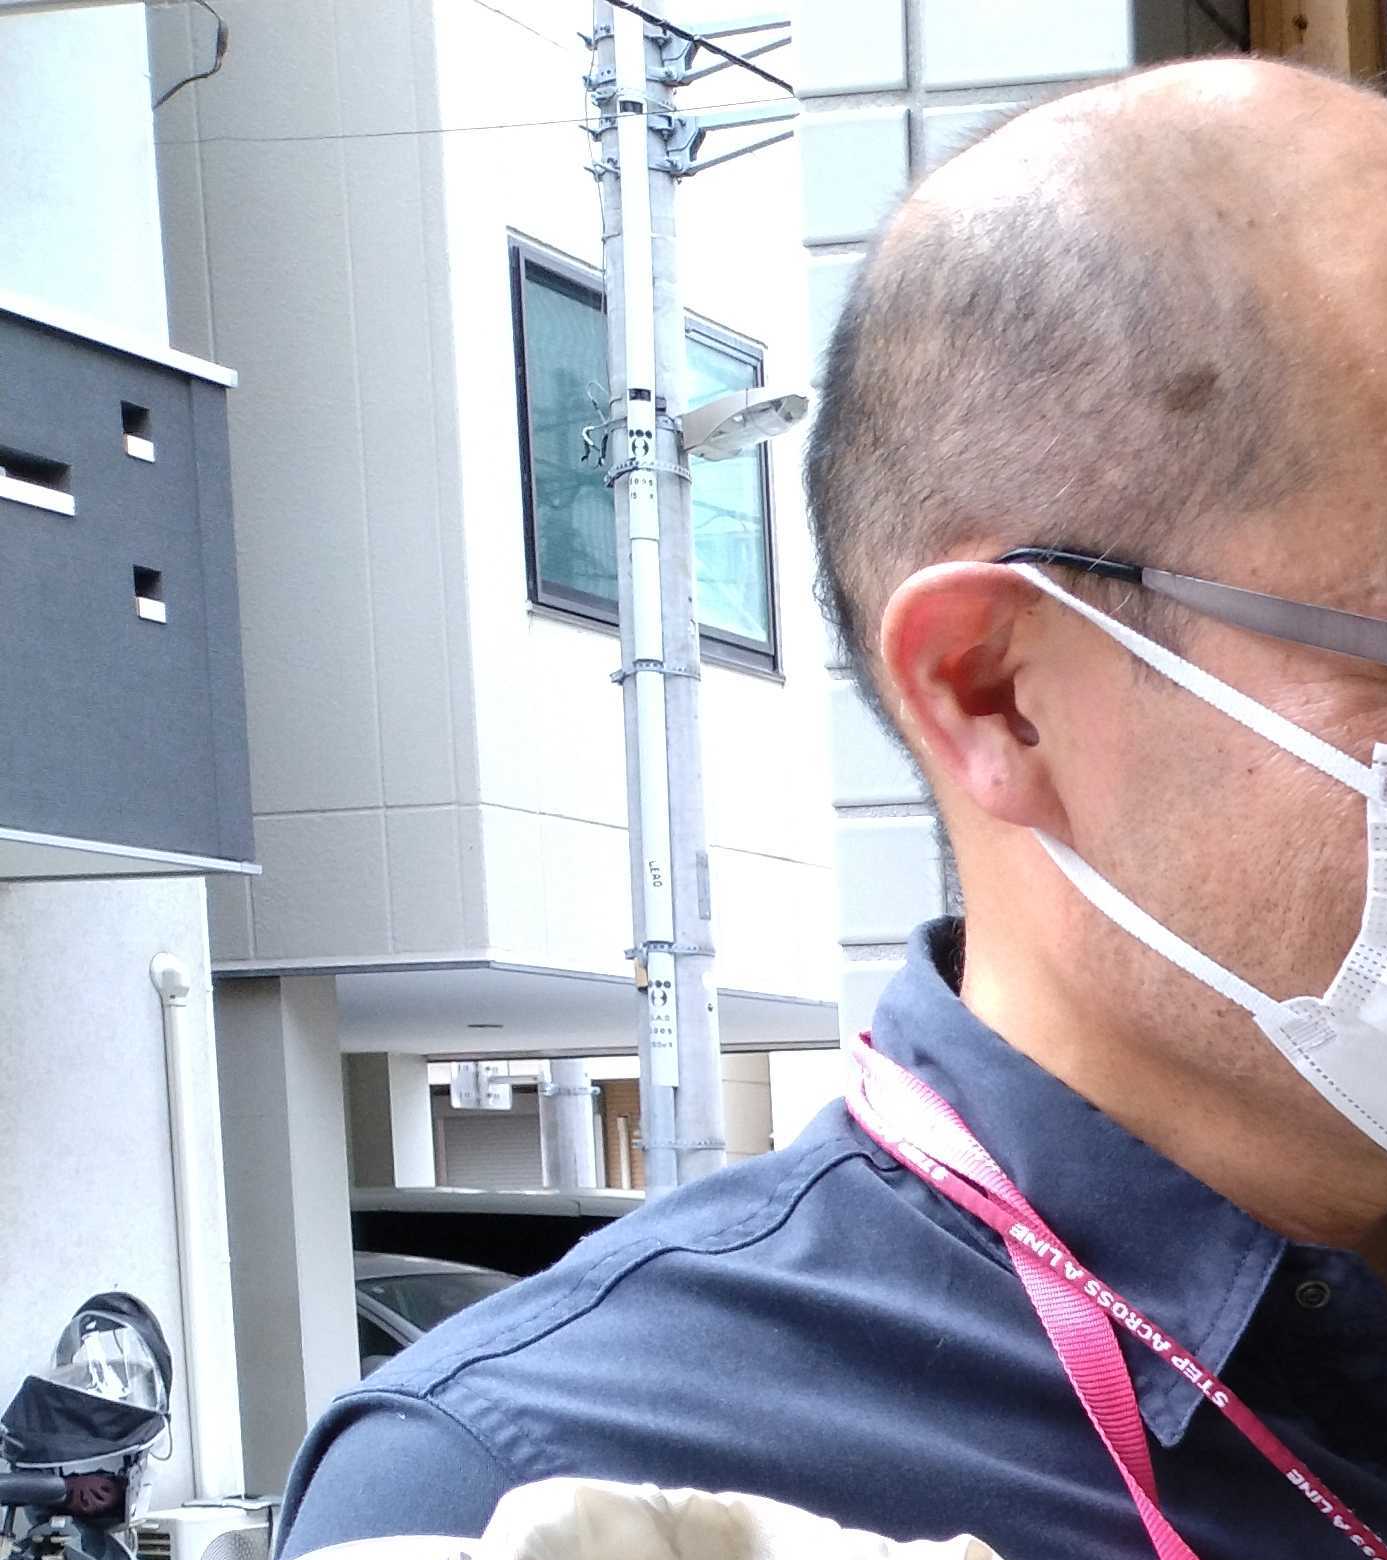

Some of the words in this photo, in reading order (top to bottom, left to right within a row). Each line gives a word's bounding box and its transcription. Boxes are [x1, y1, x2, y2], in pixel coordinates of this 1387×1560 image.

[1009, 1222, 1064, 1267] LINE
[1064, 1261, 1085, 1281] A
[1083, 1279, 1172, 1352] ACROSS
[1171, 1355, 1229, 1408] STEP
[1286, 1468, 1334, 1514] LINE
